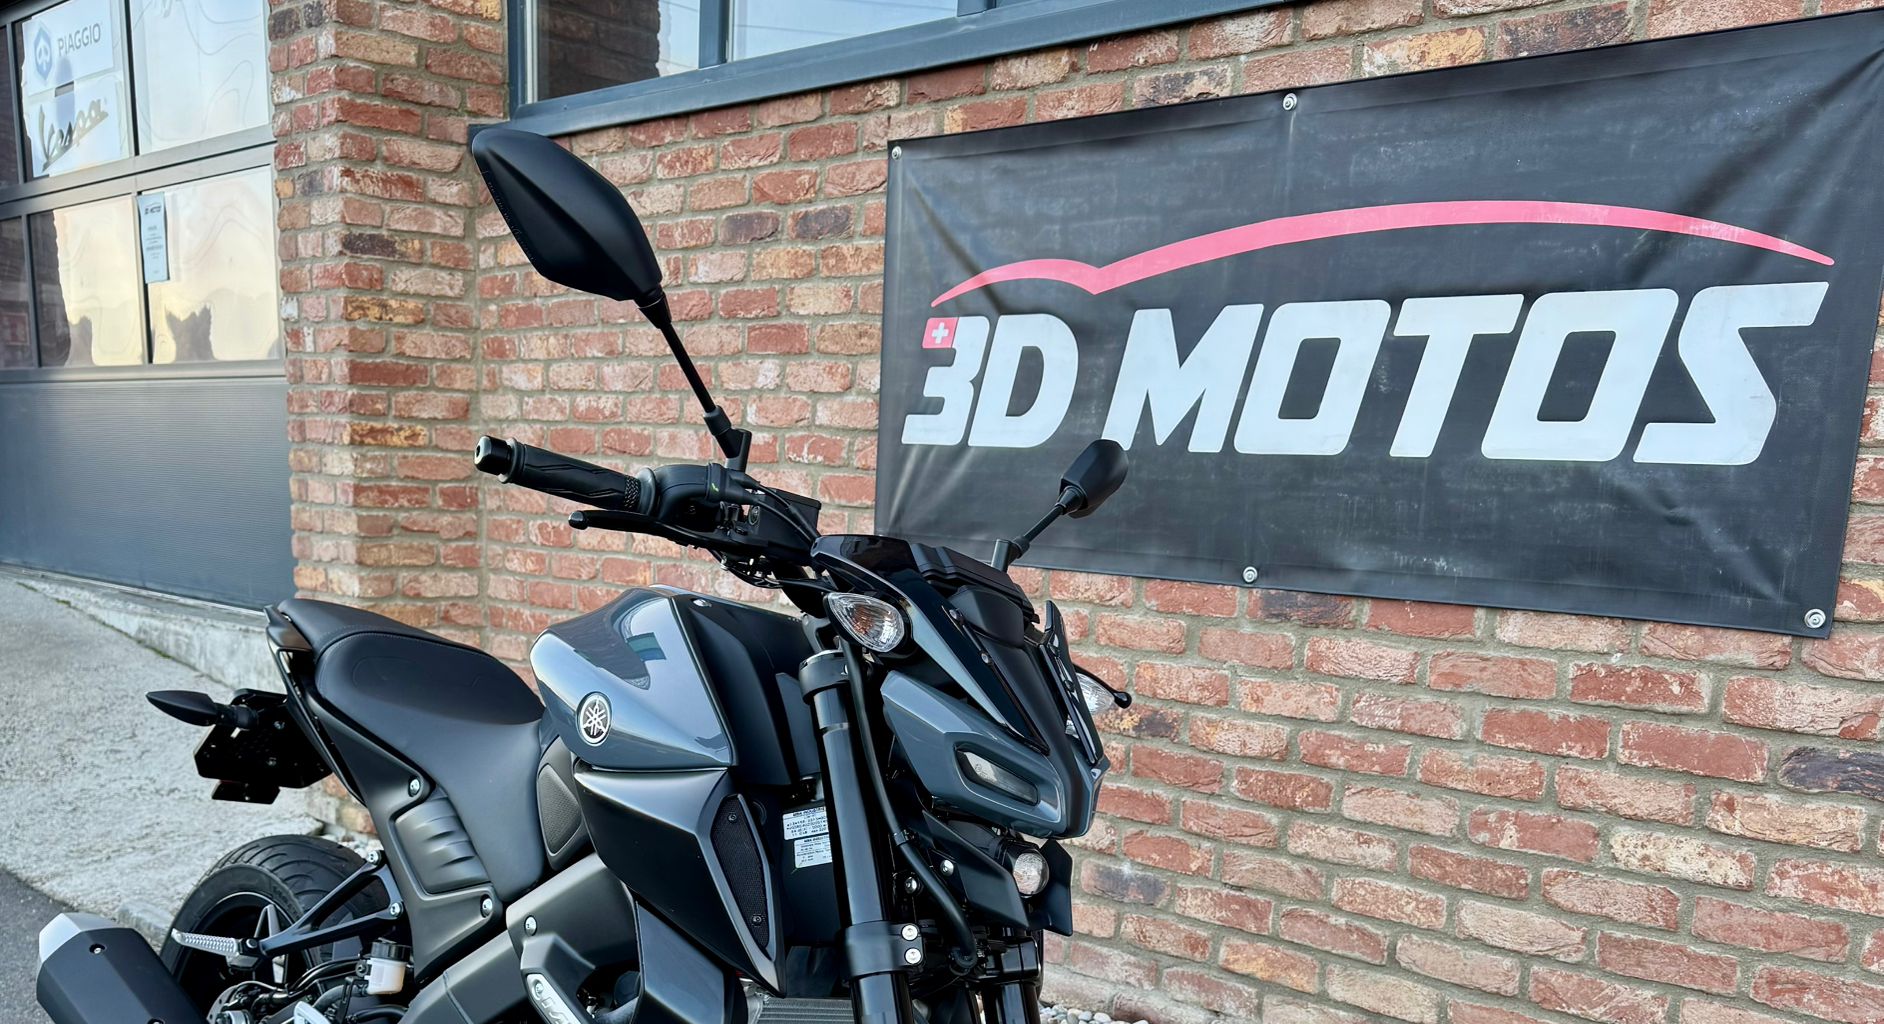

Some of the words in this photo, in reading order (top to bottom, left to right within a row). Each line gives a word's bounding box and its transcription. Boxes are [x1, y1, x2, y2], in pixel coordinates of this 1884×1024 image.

[57, 22, 102, 57] PIAGGIO
[38, 98, 109, 172] Vespa
[901, 313, 1079, 448] 3D
[1102, 281, 1830, 466] MOTOS
